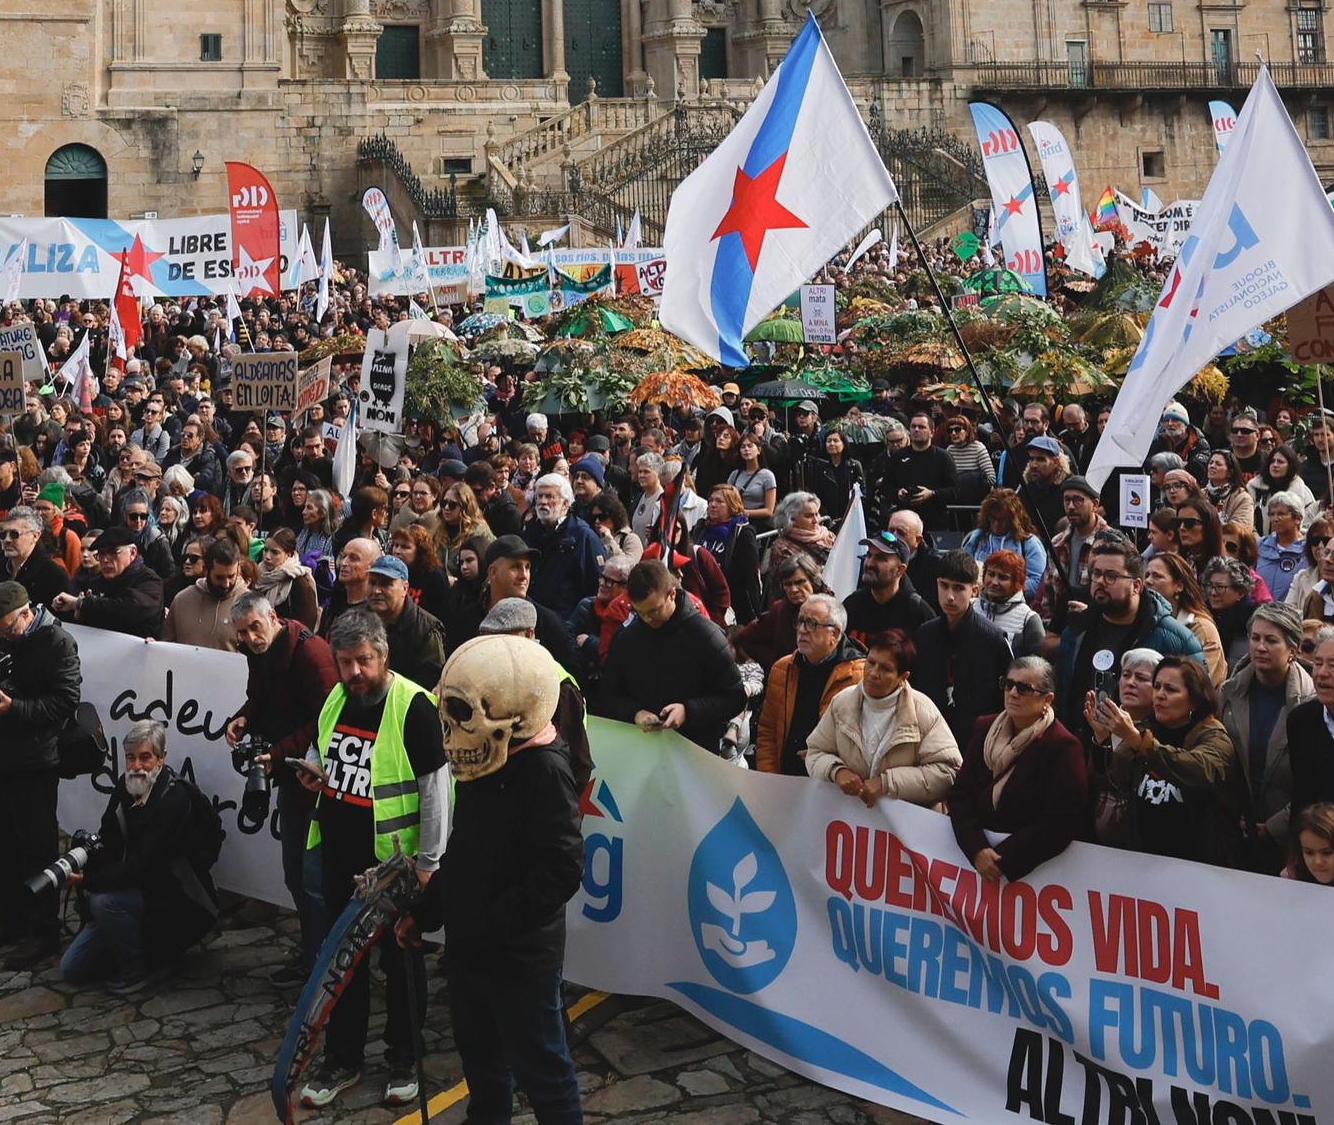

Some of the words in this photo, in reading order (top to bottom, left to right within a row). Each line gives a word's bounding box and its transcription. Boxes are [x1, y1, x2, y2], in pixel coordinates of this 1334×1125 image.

[169, 233, 227, 255] LIBRE
[168, 262, 196, 281] DE
[808, 295, 826, 303] mata
[234, 359, 295, 382] ALDEANAS
[373, 363, 393, 374] MINA
[237, 384, 253, 406] EN
[366, 407, 396, 424] NON
[826, 820, 1073, 966] QUEREMOS
[1088, 890, 1220, 999] VIDA.
[827, 897, 1073, 1044] QUEREMOS
[1089, 978, 1311, 1108] FUTURO.
